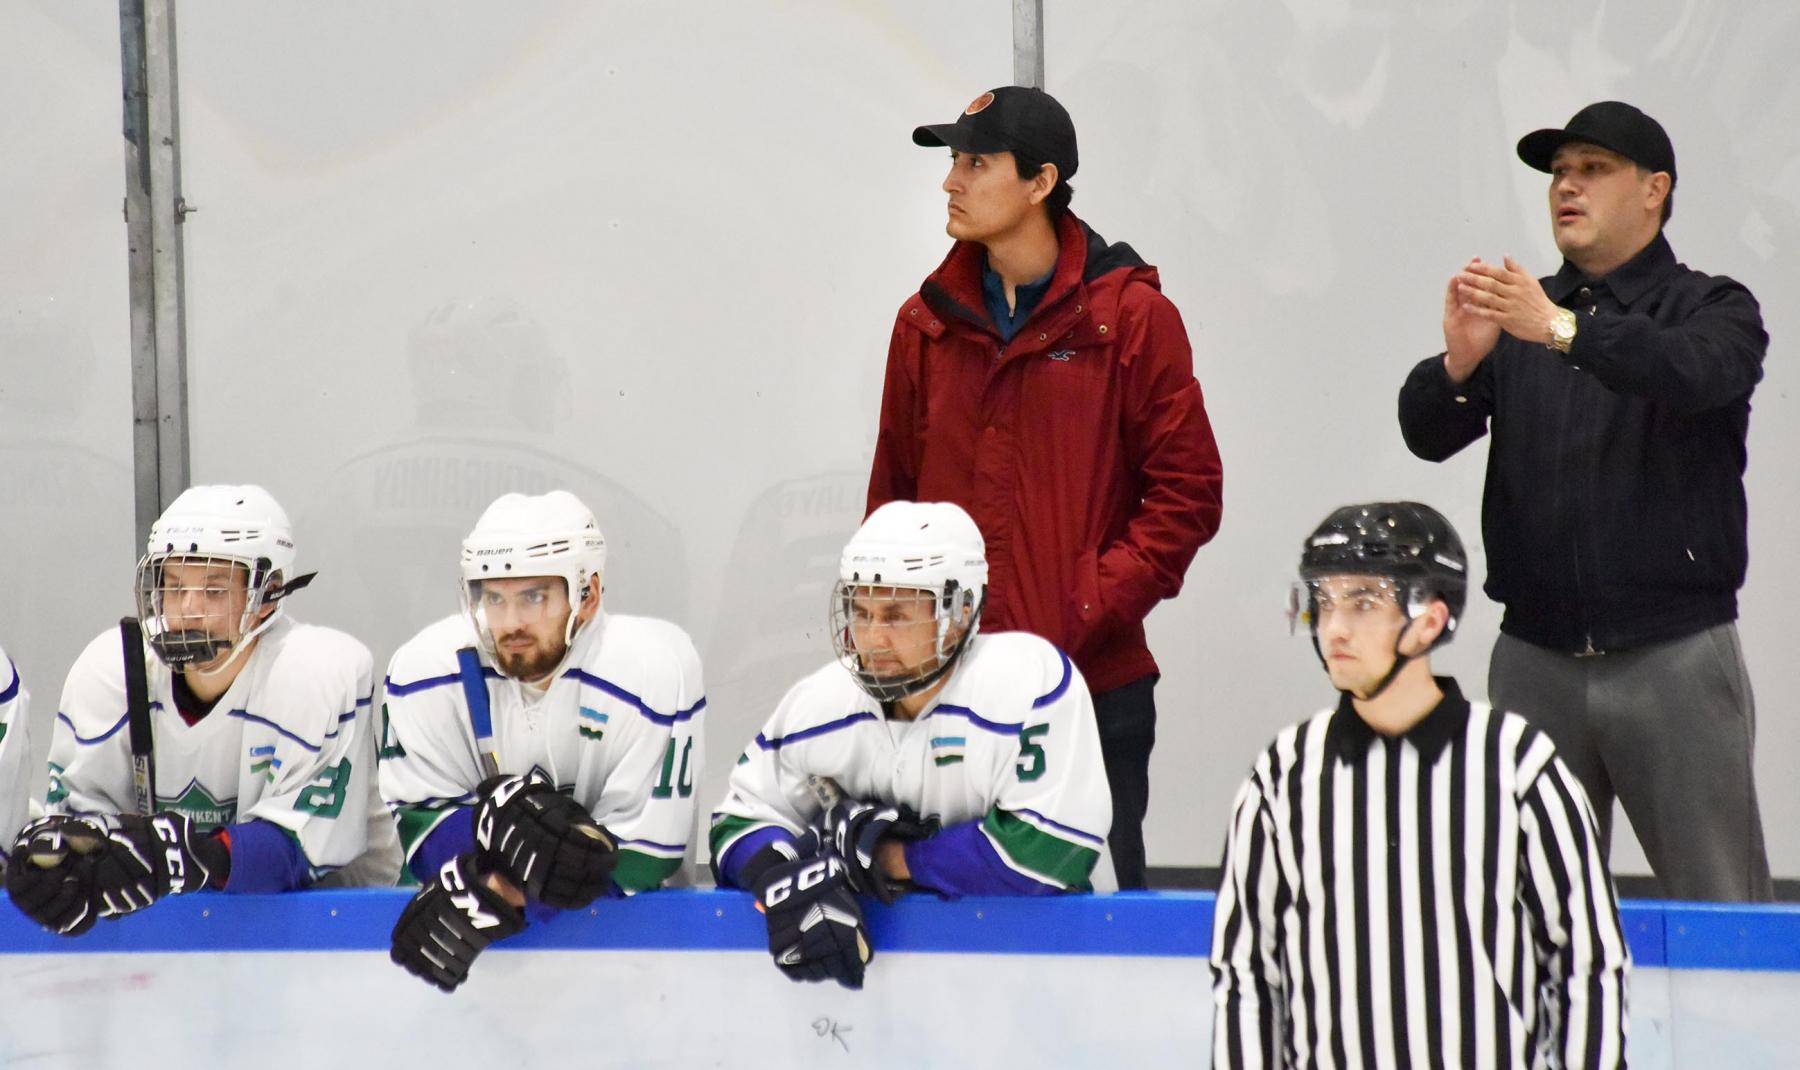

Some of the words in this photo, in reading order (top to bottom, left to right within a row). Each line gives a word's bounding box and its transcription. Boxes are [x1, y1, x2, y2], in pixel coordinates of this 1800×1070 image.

[476, 547, 513, 557] BAUER
[1016, 722, 1050, 783] 5
[439, 855, 500, 930] CM
[766, 856, 843, 908] CCM
